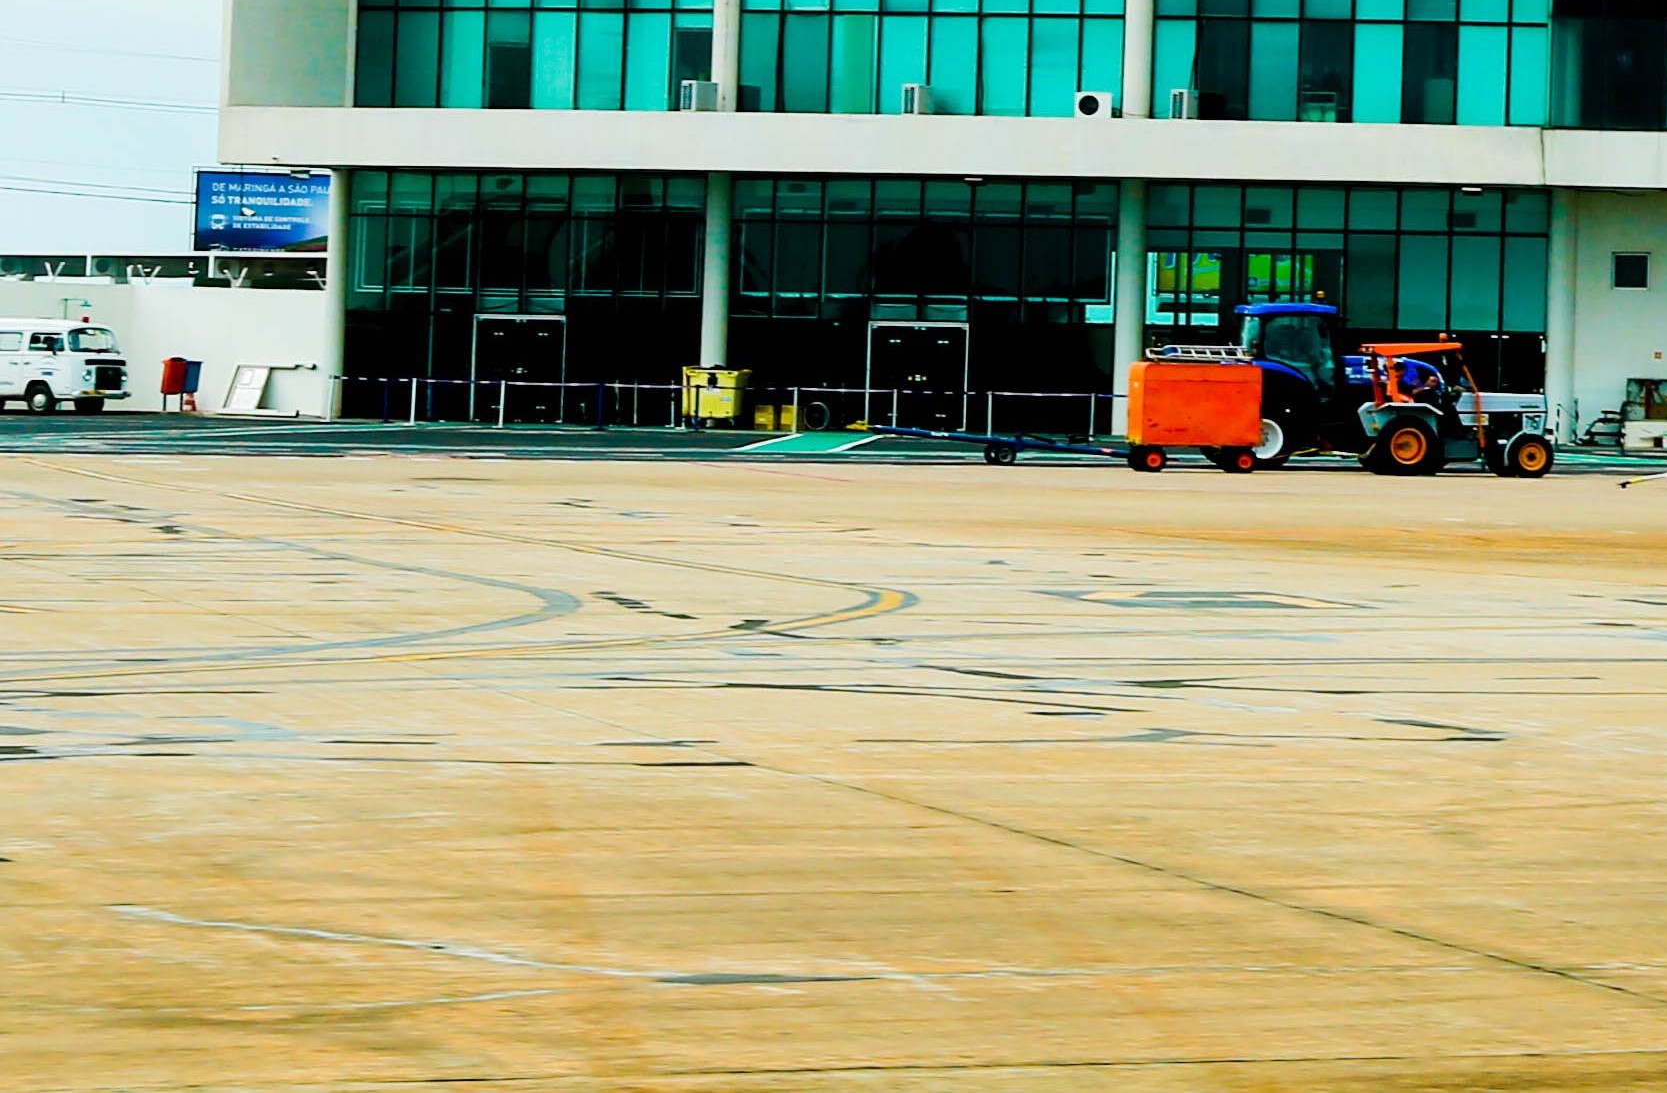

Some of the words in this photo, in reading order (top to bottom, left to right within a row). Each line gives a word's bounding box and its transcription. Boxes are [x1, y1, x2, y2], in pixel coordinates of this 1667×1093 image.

[212, 182, 226, 192] DE
[278, 185, 286, 193] A
[287, 182, 308, 194] SÃO
[211, 193, 225, 204] SÓ
